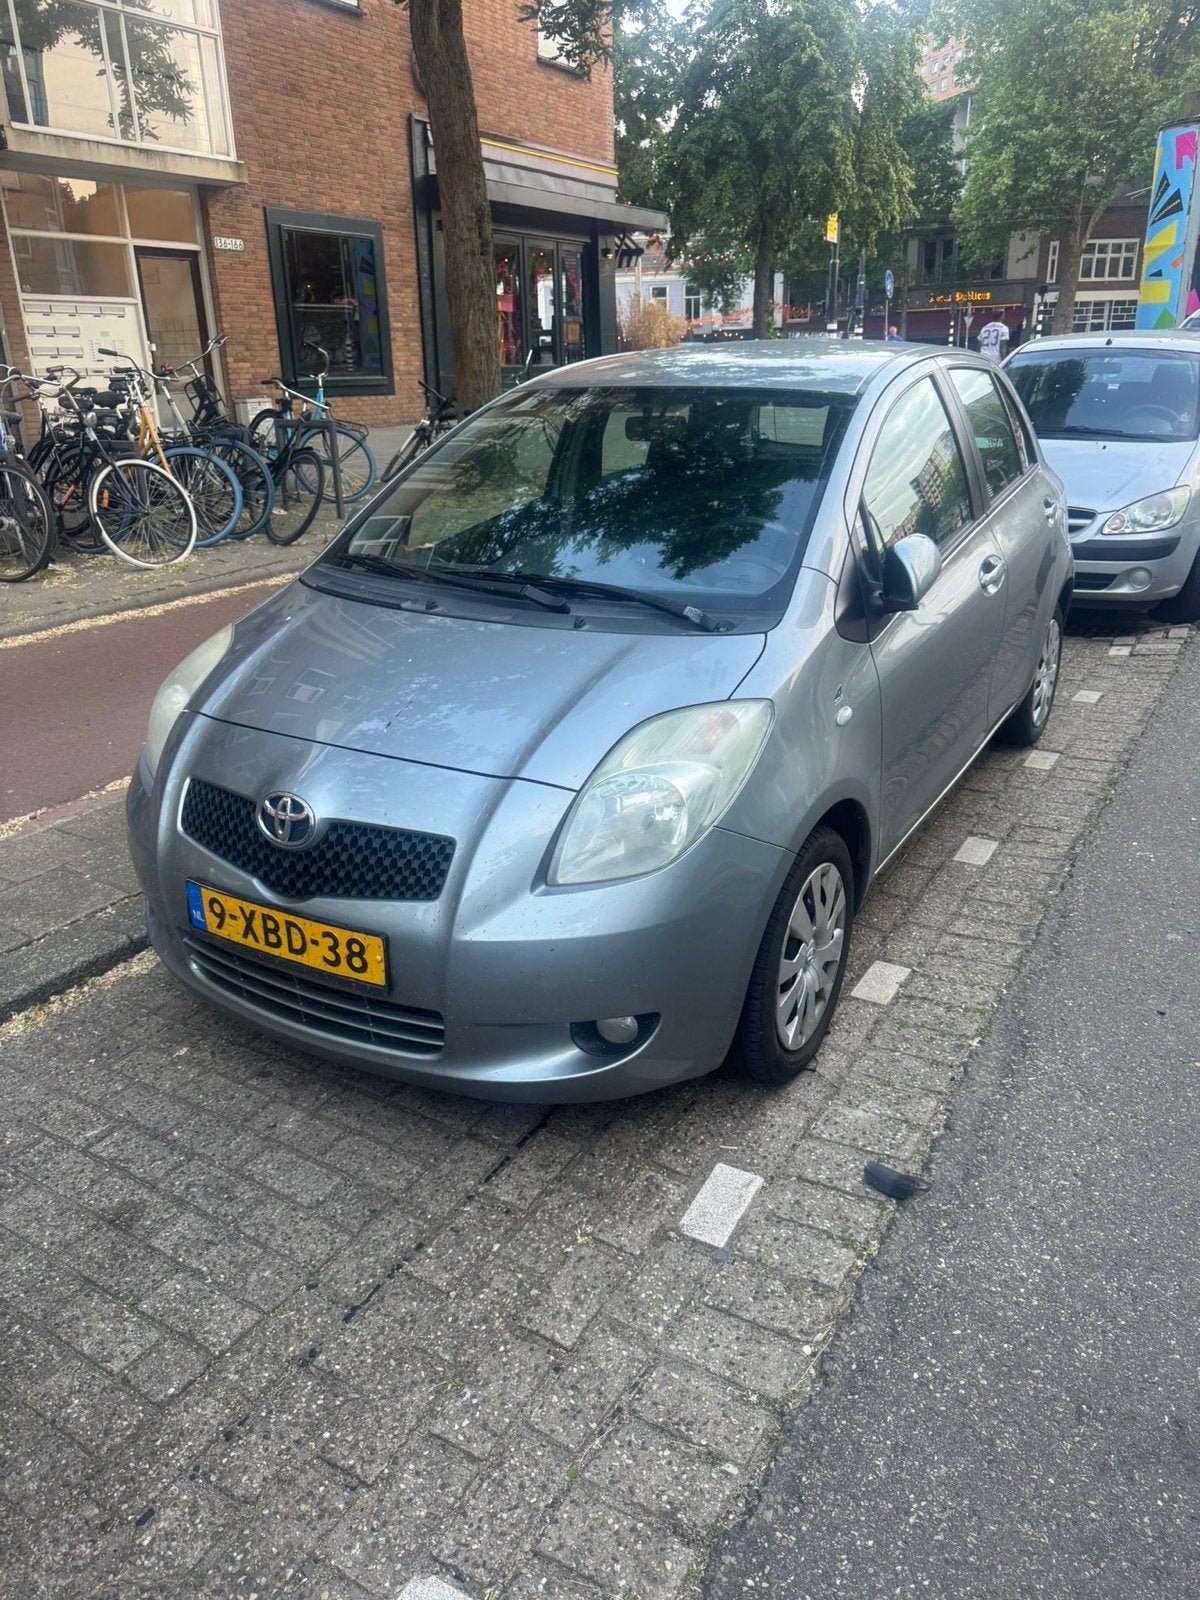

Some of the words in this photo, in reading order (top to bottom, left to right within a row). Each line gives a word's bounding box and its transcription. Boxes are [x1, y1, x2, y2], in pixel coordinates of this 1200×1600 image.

[983, 328, 1000, 347] 23
[192, 908, 205, 922] NL
[208, 896, 368, 974] 9-XBD-38
